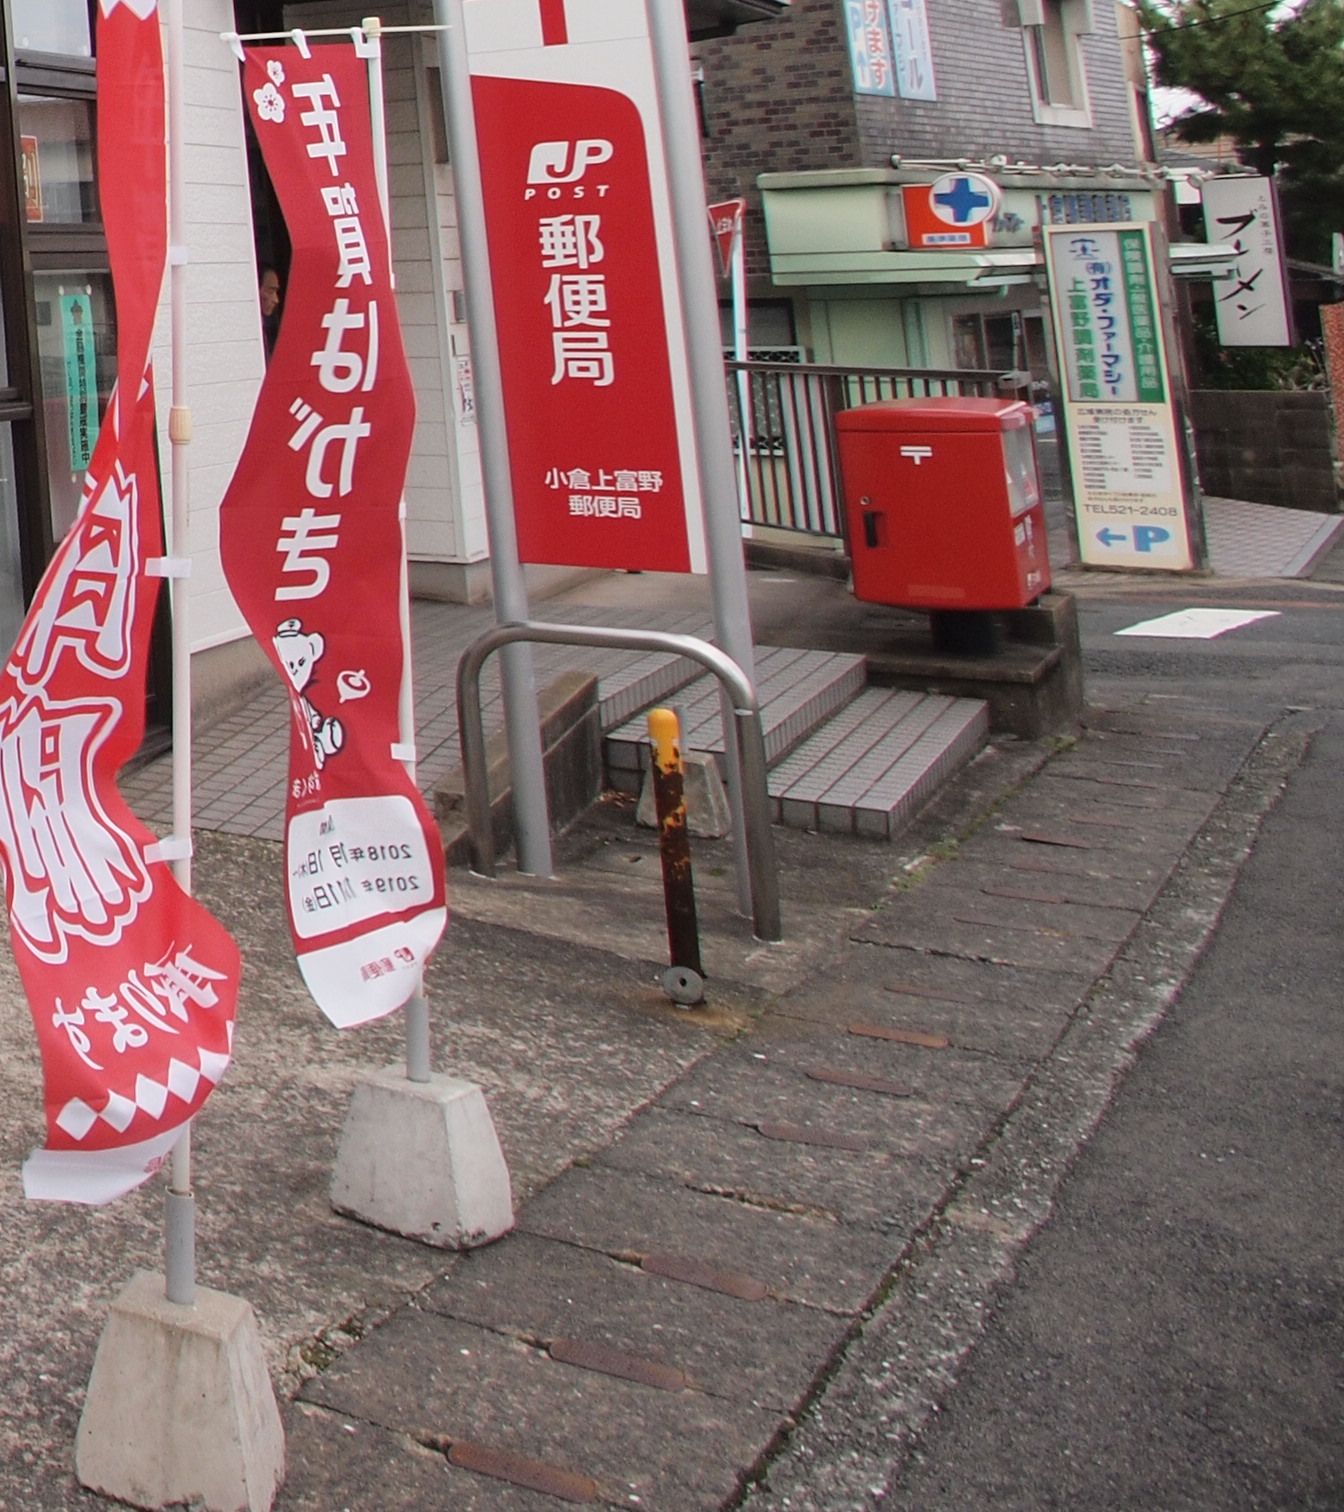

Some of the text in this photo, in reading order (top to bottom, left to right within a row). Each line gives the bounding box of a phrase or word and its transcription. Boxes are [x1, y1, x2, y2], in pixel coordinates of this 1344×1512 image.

[524, 184, 610, 201] POST
[538, 212, 616, 388] 郵便局
[543, 468, 664, 494] 小倉上富野
[568, 494, 642, 521] 郵便局
[1132, 525, 1170, 552] P
